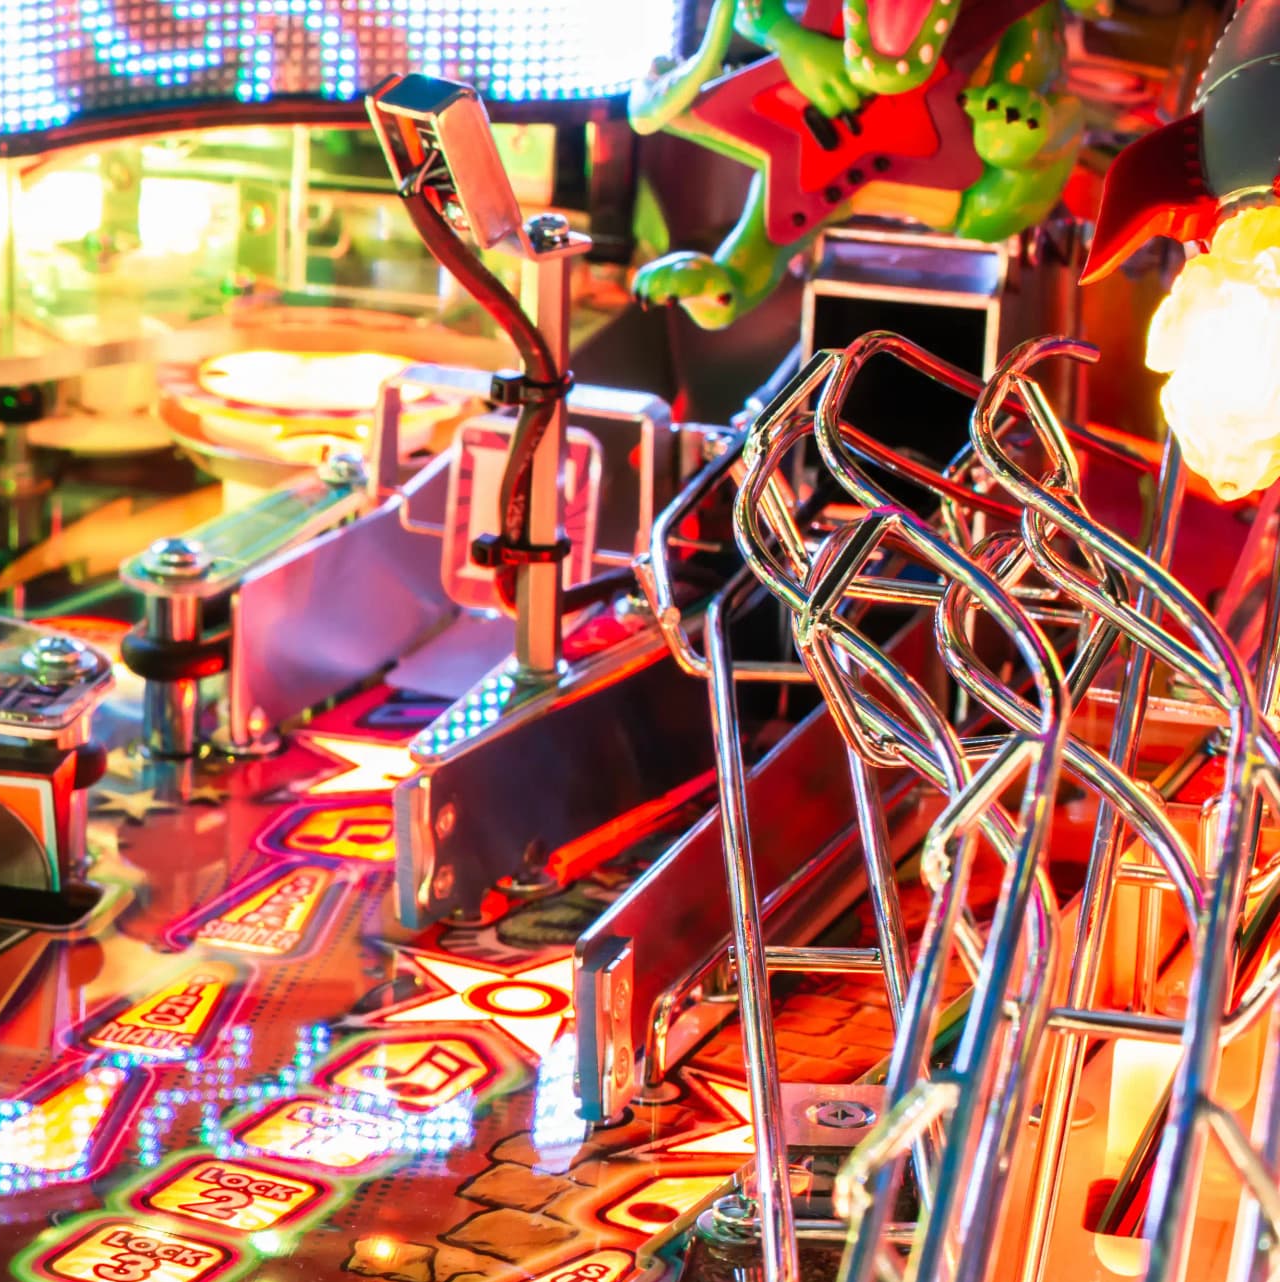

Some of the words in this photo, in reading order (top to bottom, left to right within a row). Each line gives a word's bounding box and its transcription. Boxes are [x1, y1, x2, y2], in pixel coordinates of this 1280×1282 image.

[197, 917, 302, 949] SPINNER
[193, 1166, 304, 1202] LOCK
[178, 1188, 254, 1221] 2
[100, 1229, 214, 1268] LOCK
